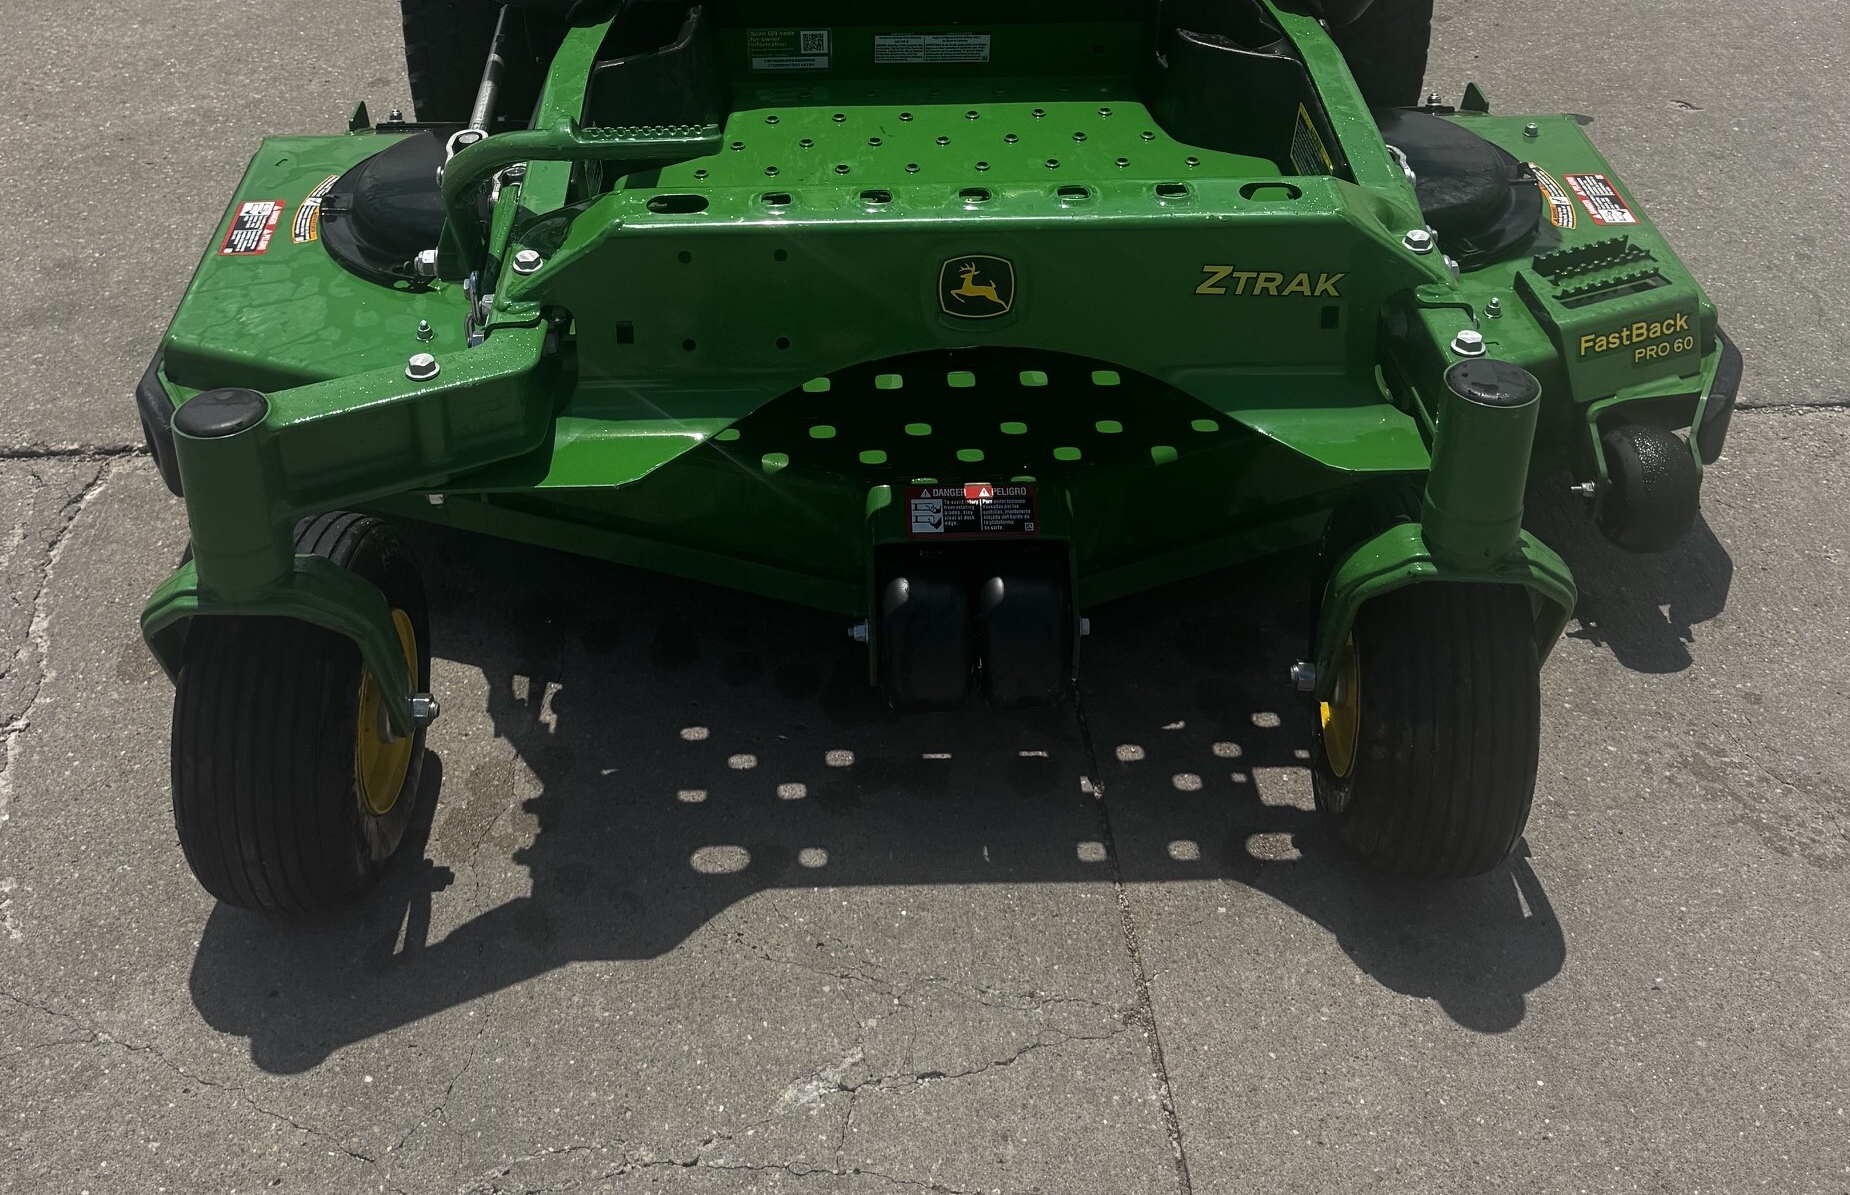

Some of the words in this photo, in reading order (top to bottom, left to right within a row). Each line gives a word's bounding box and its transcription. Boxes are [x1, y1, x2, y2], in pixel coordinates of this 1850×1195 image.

[1195, 265, 1345, 296] ZTRAK
[1580, 313, 1689, 356] FastBack
[1634, 342, 1670, 363] PRO
[1673, 336, 1694, 353] 60
[932, 488, 967, 497] DANGER
[991, 487, 1027, 497] PELIGRO
